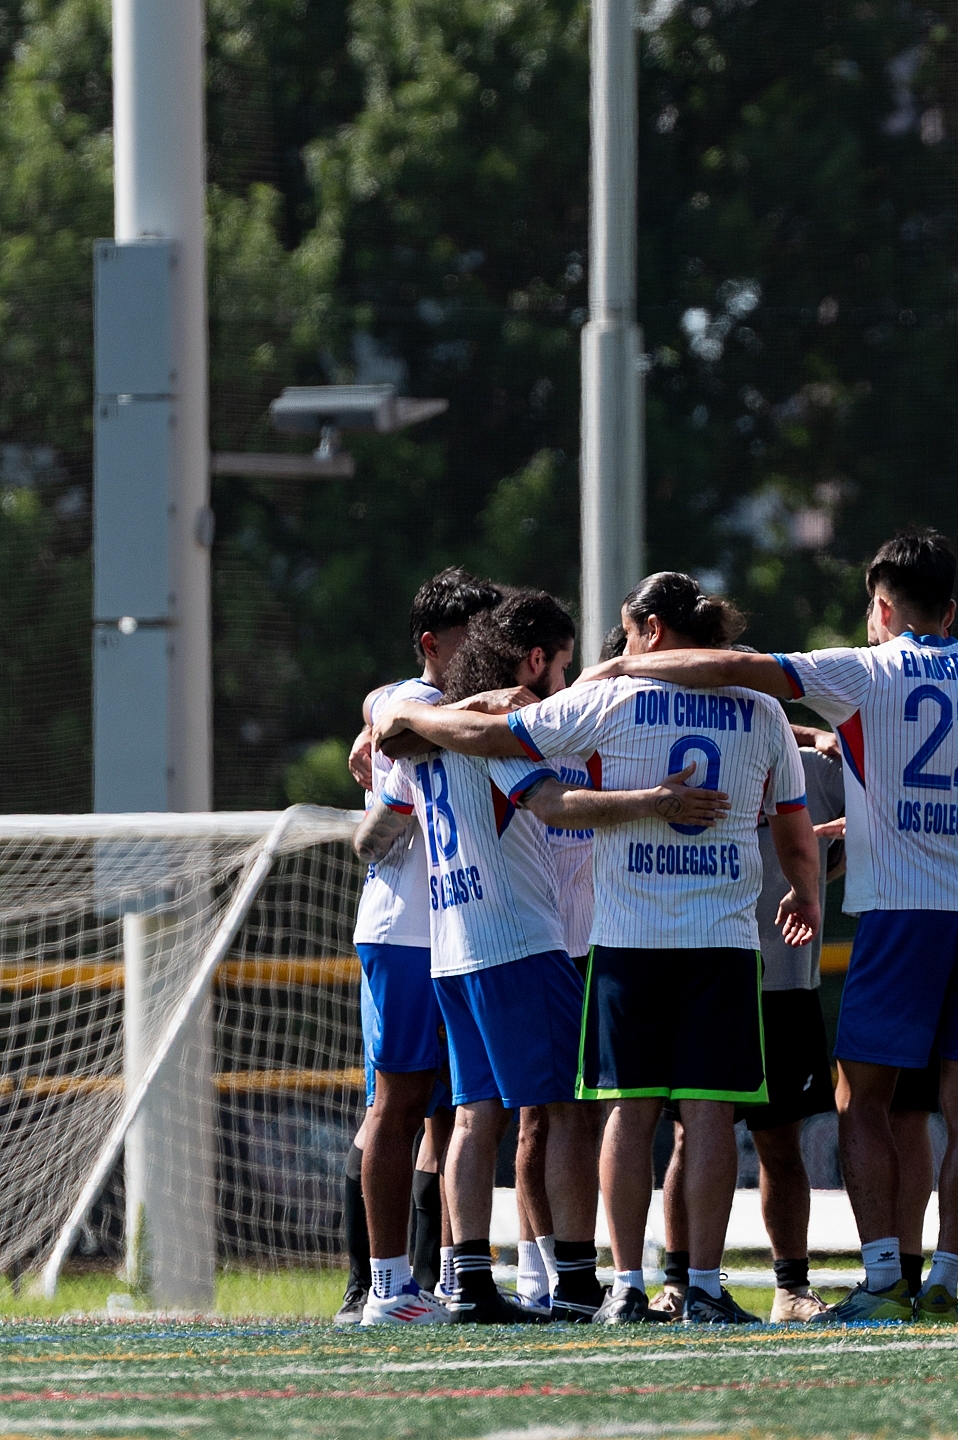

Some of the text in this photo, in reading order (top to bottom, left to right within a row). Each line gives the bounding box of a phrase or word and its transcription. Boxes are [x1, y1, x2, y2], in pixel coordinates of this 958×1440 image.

[900, 650, 922, 678] EL
[635, 689, 755, 732] DON CHARRY
[897, 800, 922, 833] LOS
[628, 842, 740, 881] LOS COLEGAS FC
